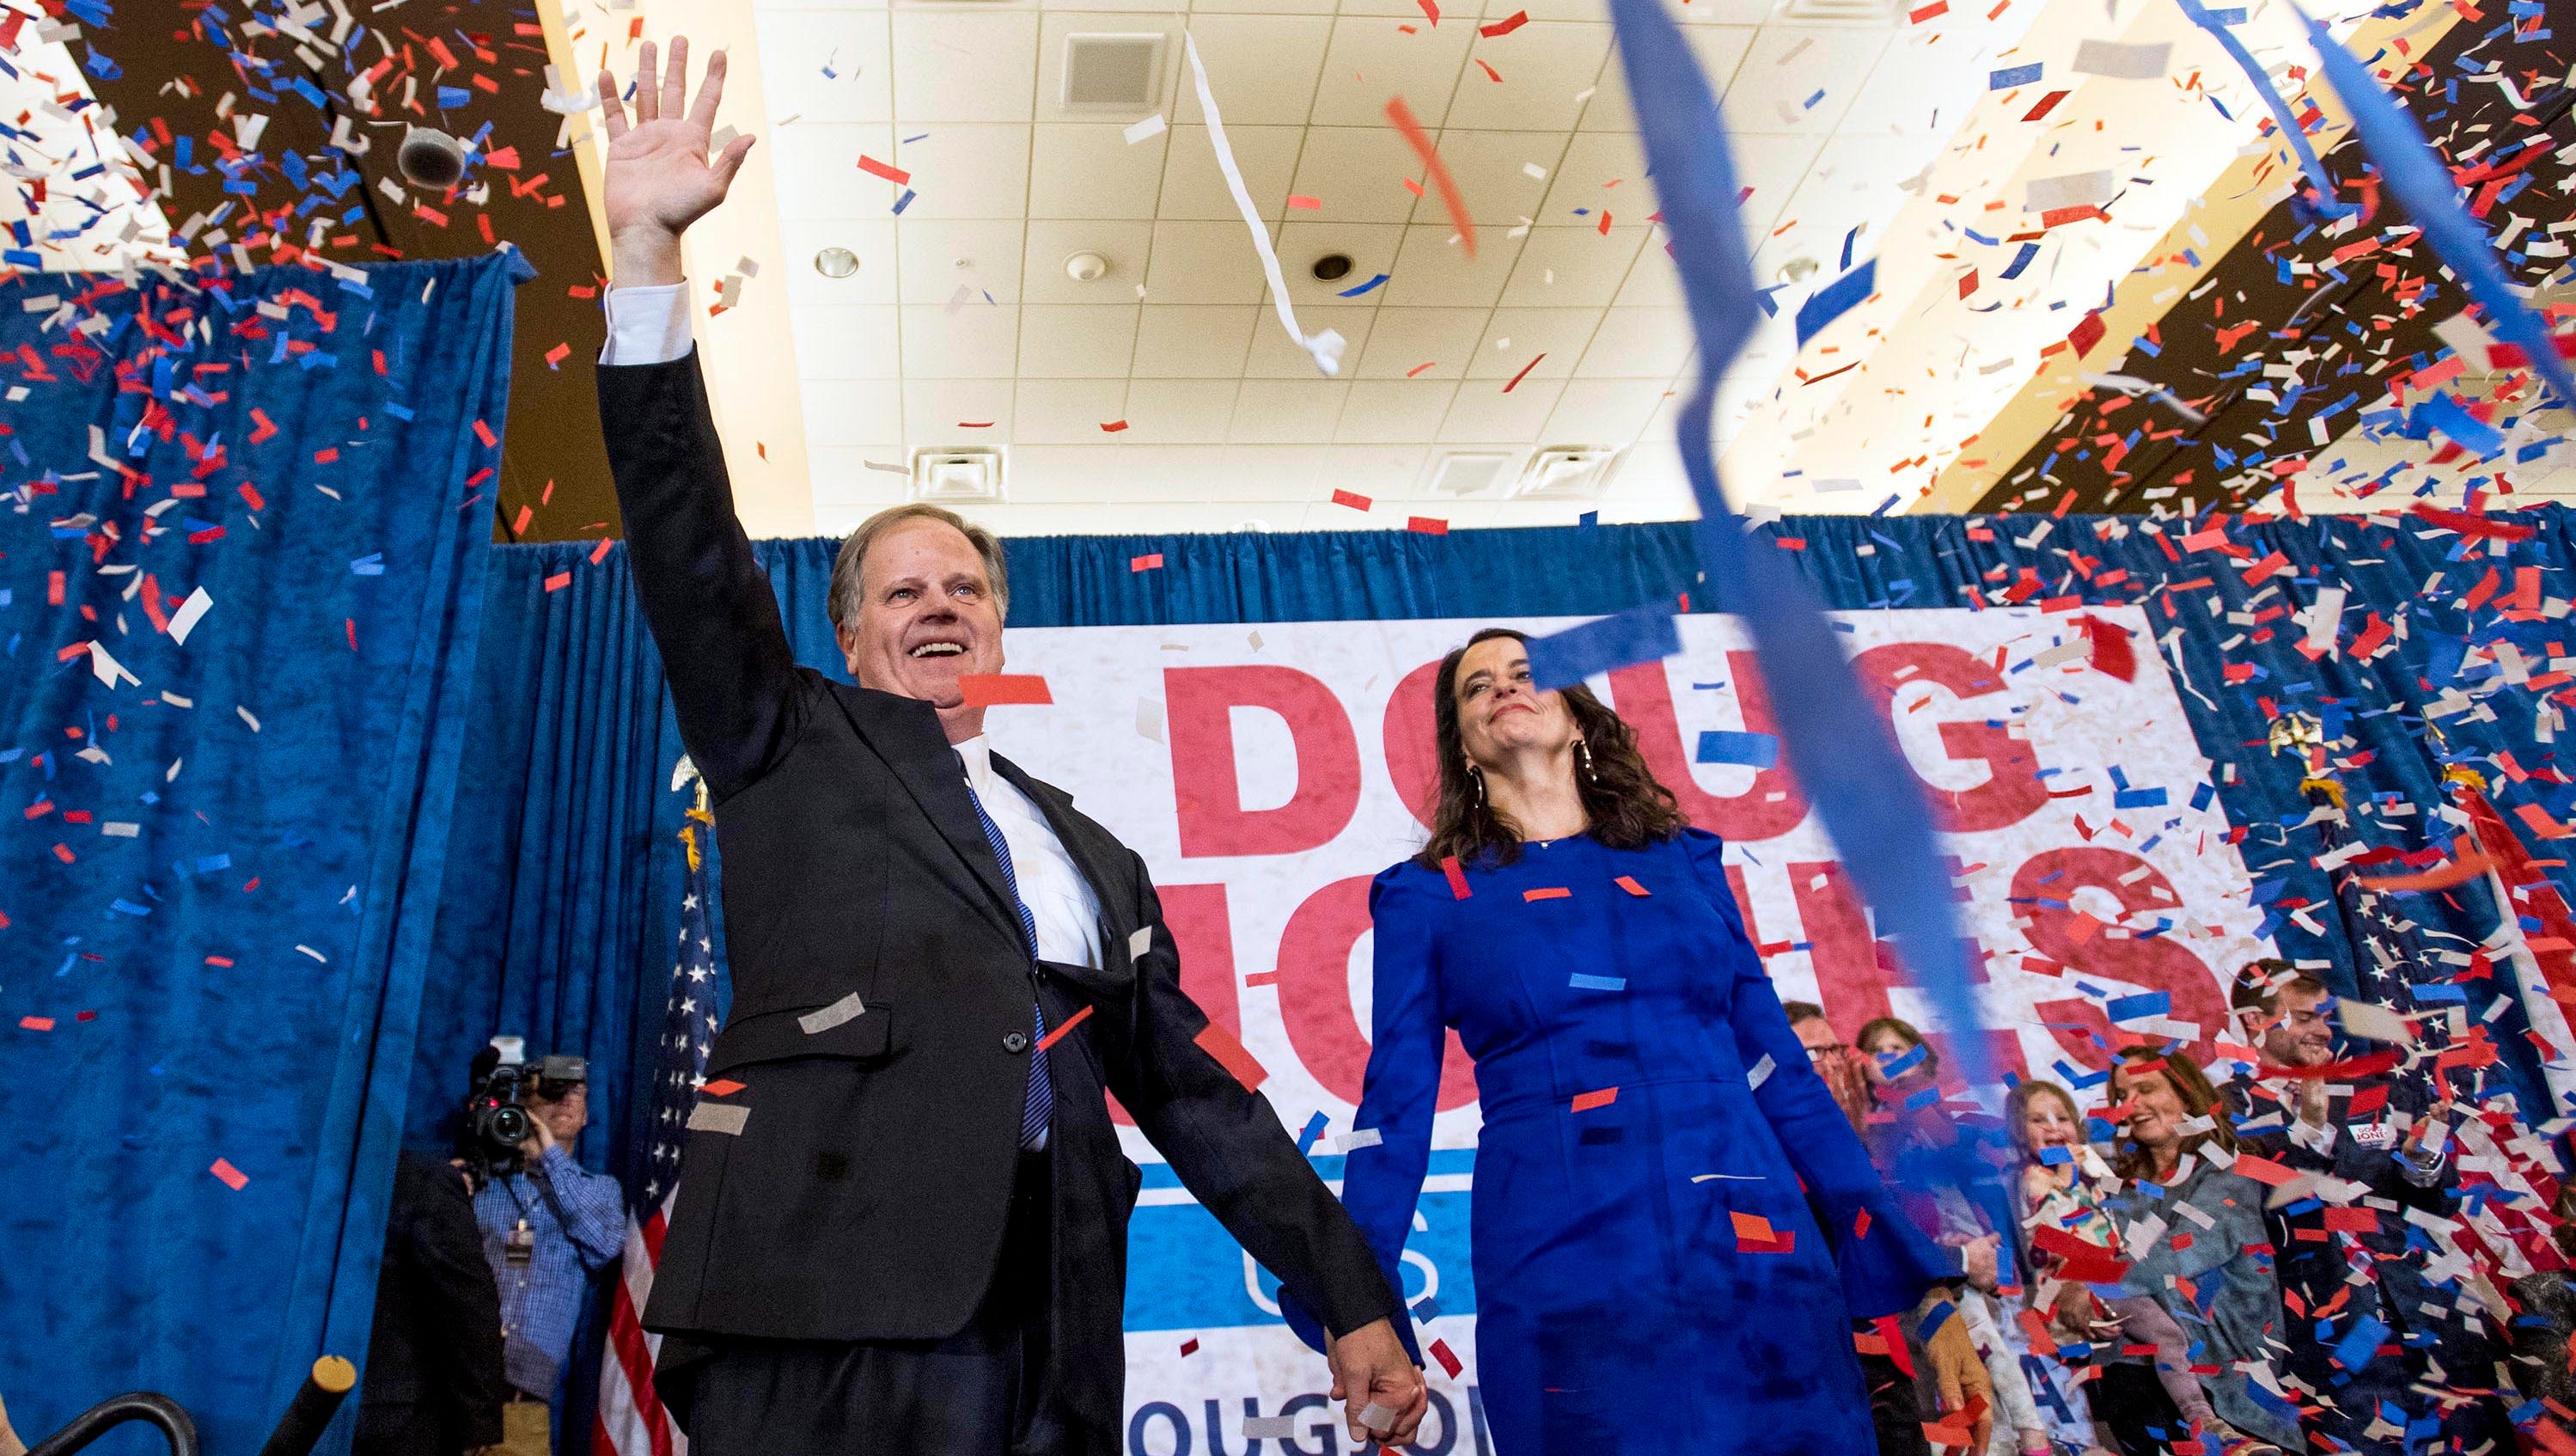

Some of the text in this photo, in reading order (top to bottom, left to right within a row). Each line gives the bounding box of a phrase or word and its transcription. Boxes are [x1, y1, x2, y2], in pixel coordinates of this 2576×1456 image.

[1164, 642, 2050, 859] DUG
[1105, 847, 2230, 1126] JOES
[2357, 1131, 2387, 1140] JONE
